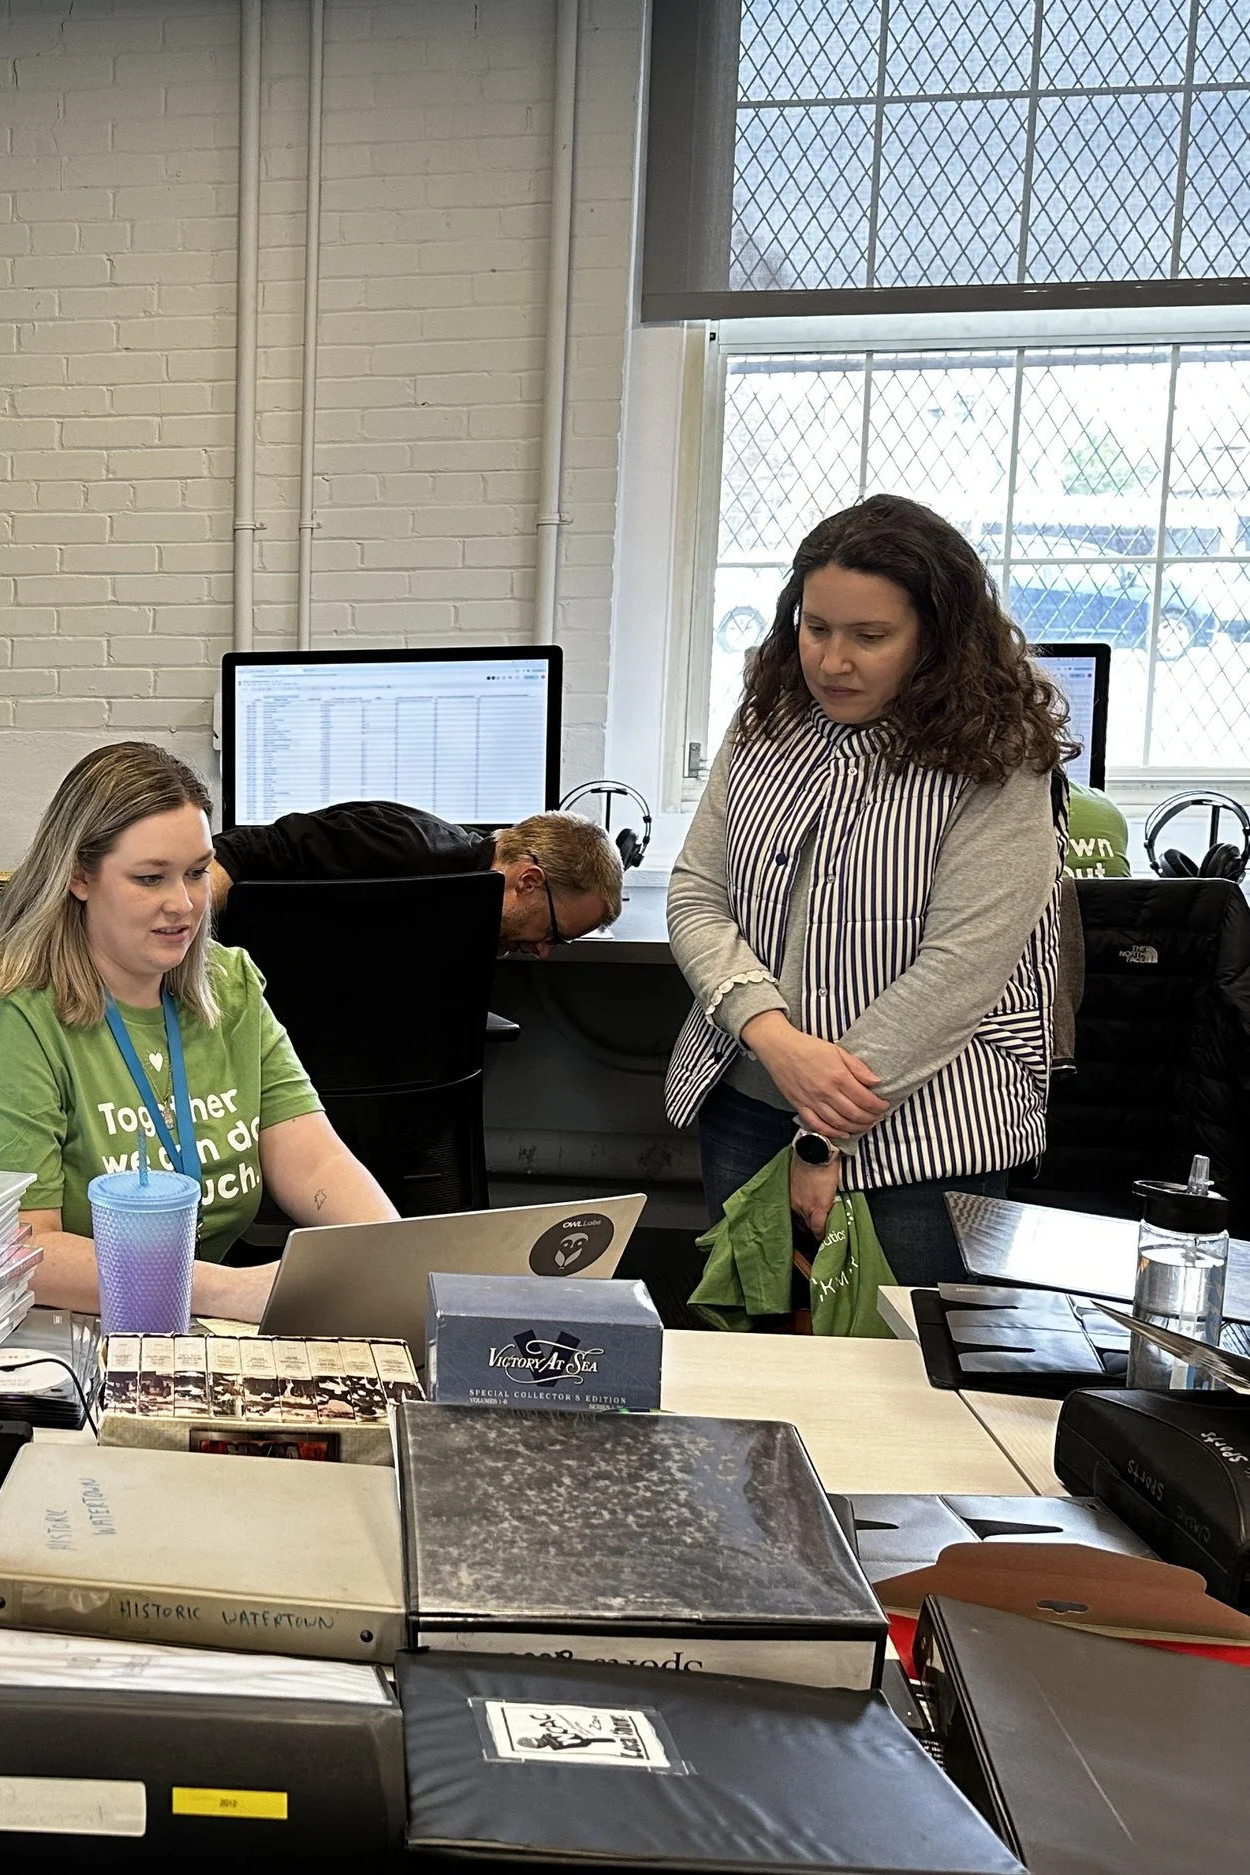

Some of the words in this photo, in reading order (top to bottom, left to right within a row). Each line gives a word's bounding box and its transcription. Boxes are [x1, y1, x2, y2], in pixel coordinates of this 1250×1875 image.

[1065, 837, 1115, 858] wn
[1118, 950, 1147, 958] NORTH
[97, 1088, 238, 1138] Togher
[158, 1137, 221, 1171] cn
[201, 1162, 261, 1206] uch.
[469, 1388, 510, 1398] SPECIAL
[514, 1390, 581, 1402] COLLECTOR'S
[586, 1394, 627, 1405] EDITION
[119, 1599, 201, 1621] HISTORIC
[222, 1609, 335, 1630] WATERTOWN
